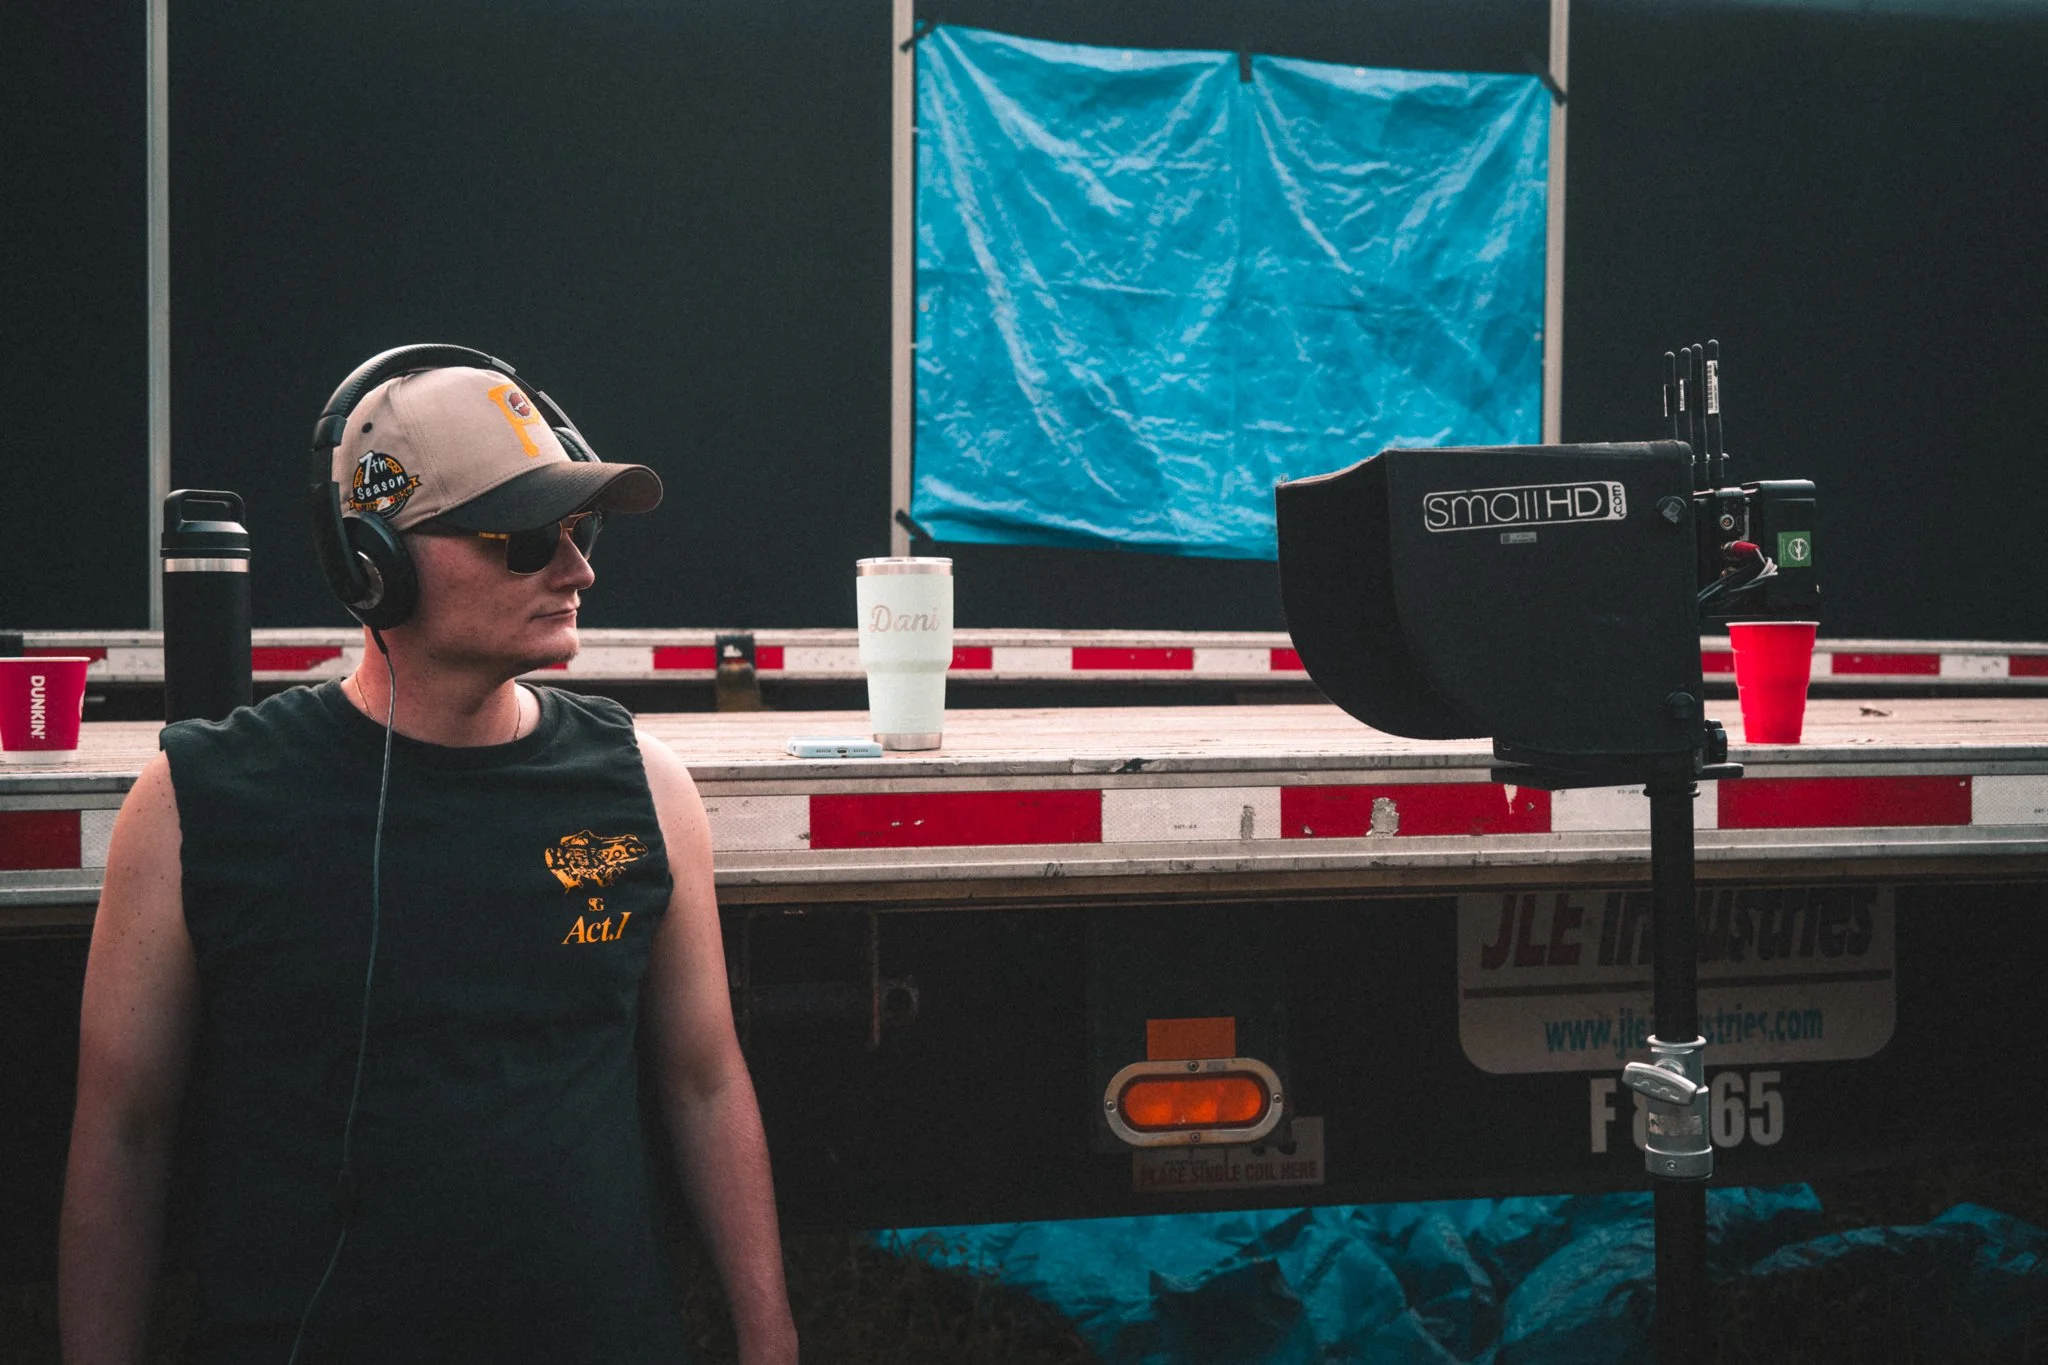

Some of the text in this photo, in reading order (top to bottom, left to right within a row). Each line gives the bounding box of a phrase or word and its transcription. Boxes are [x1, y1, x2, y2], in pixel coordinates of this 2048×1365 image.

[358, 451, 387, 485] 7th
[356, 475, 405, 500] Season
[868, 604, 940, 633] Dani
[30, 674, 46, 740] DUNKIN'
[1481, 887, 1879, 970] JLE Inustries
[1246, 1161, 1275, 1180] COIL
[1281, 1160, 1318, 1179] HERE
